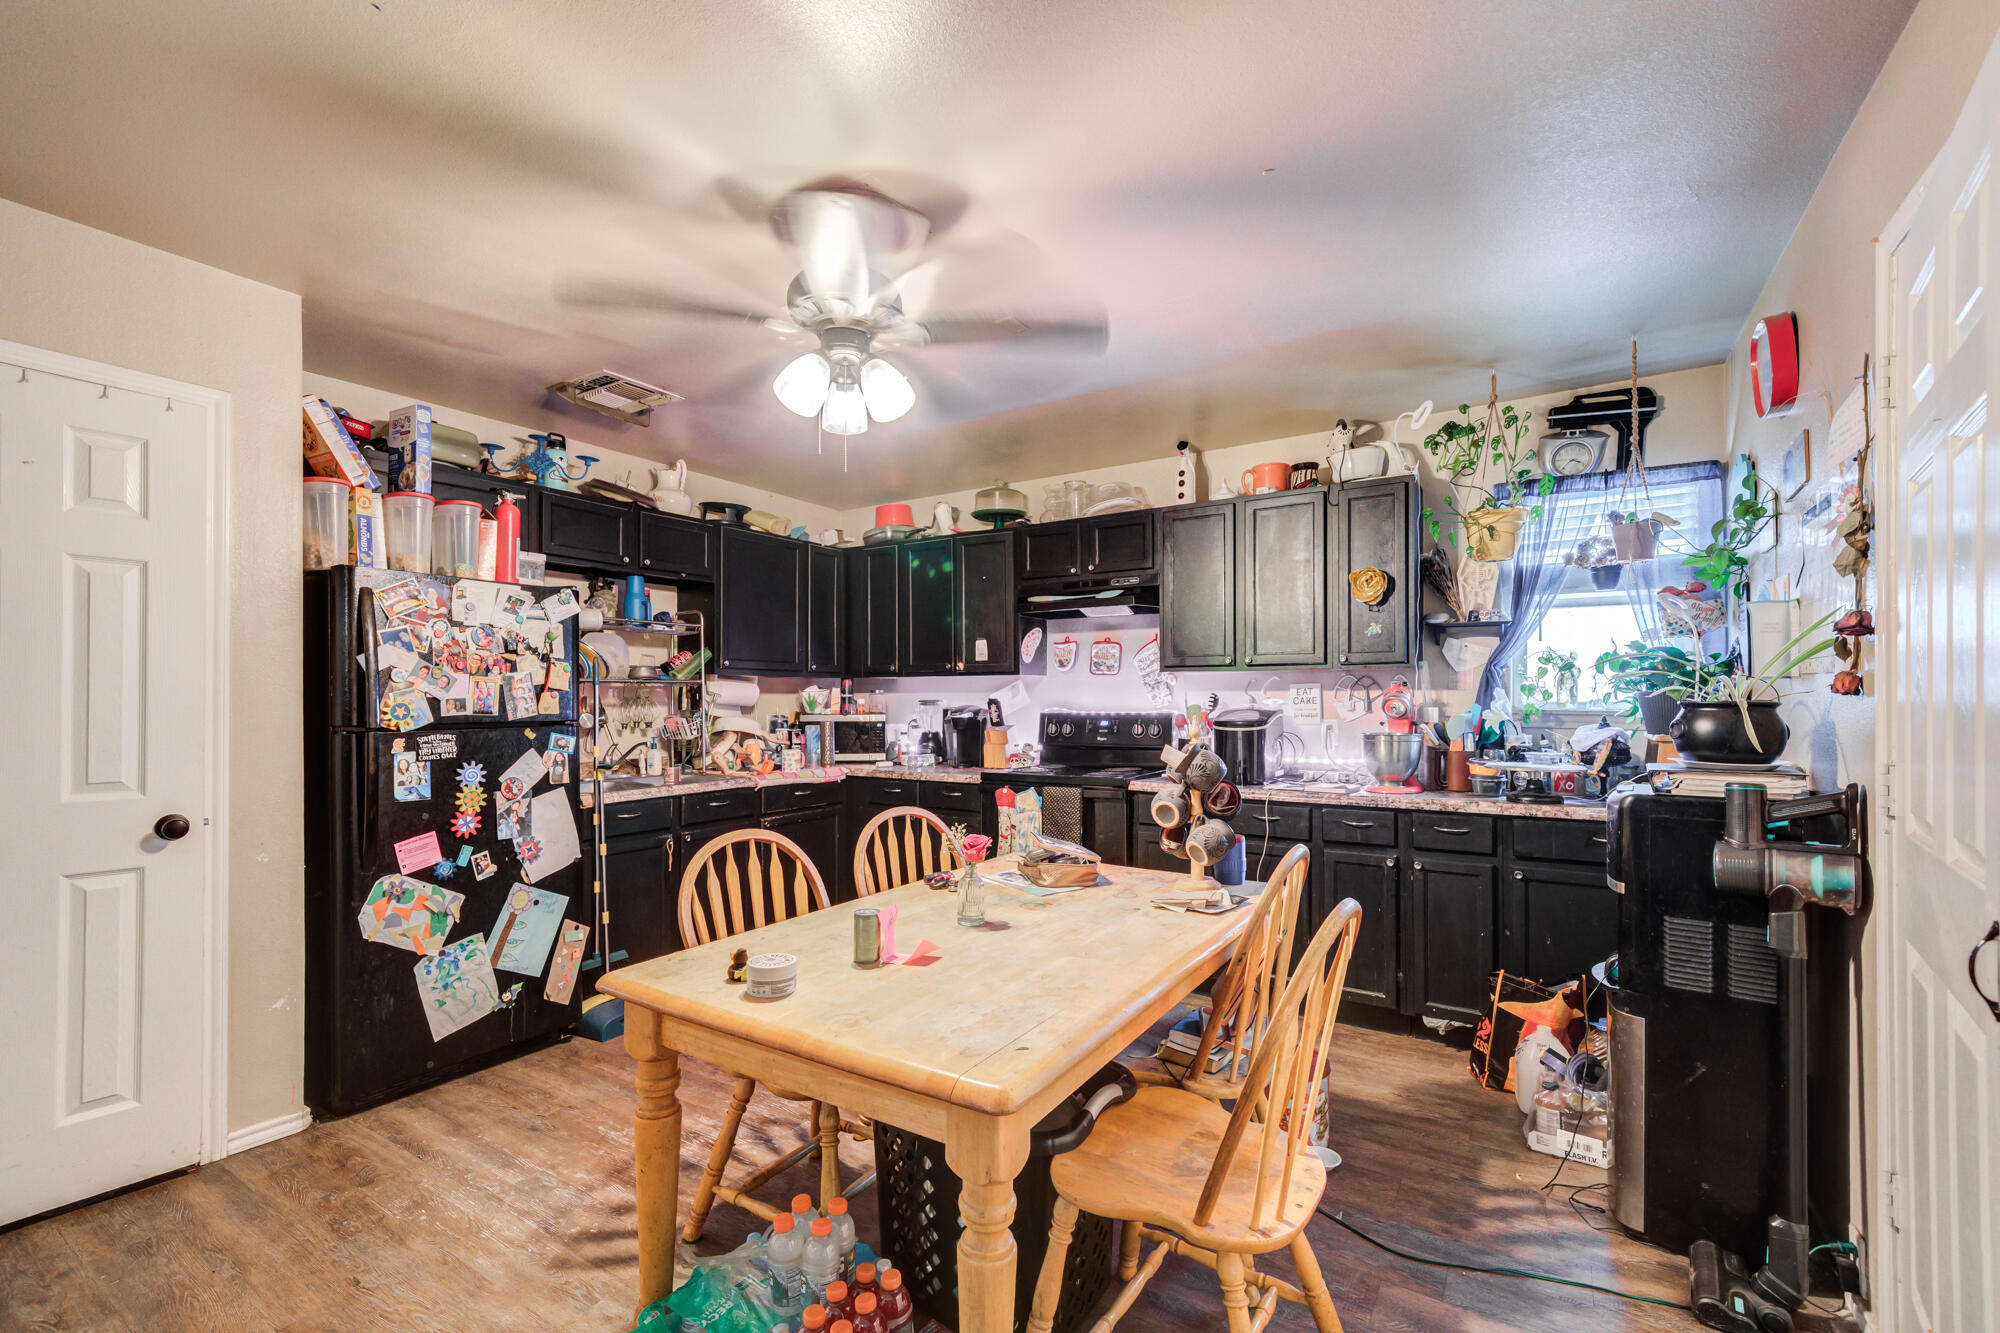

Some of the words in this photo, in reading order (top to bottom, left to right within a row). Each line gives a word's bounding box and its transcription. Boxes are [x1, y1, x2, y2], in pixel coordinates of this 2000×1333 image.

[359, 517, 368, 552] ALMONDS
[1296, 687, 1313, 696] EAT
[1292, 696, 1318, 705] CAKE
